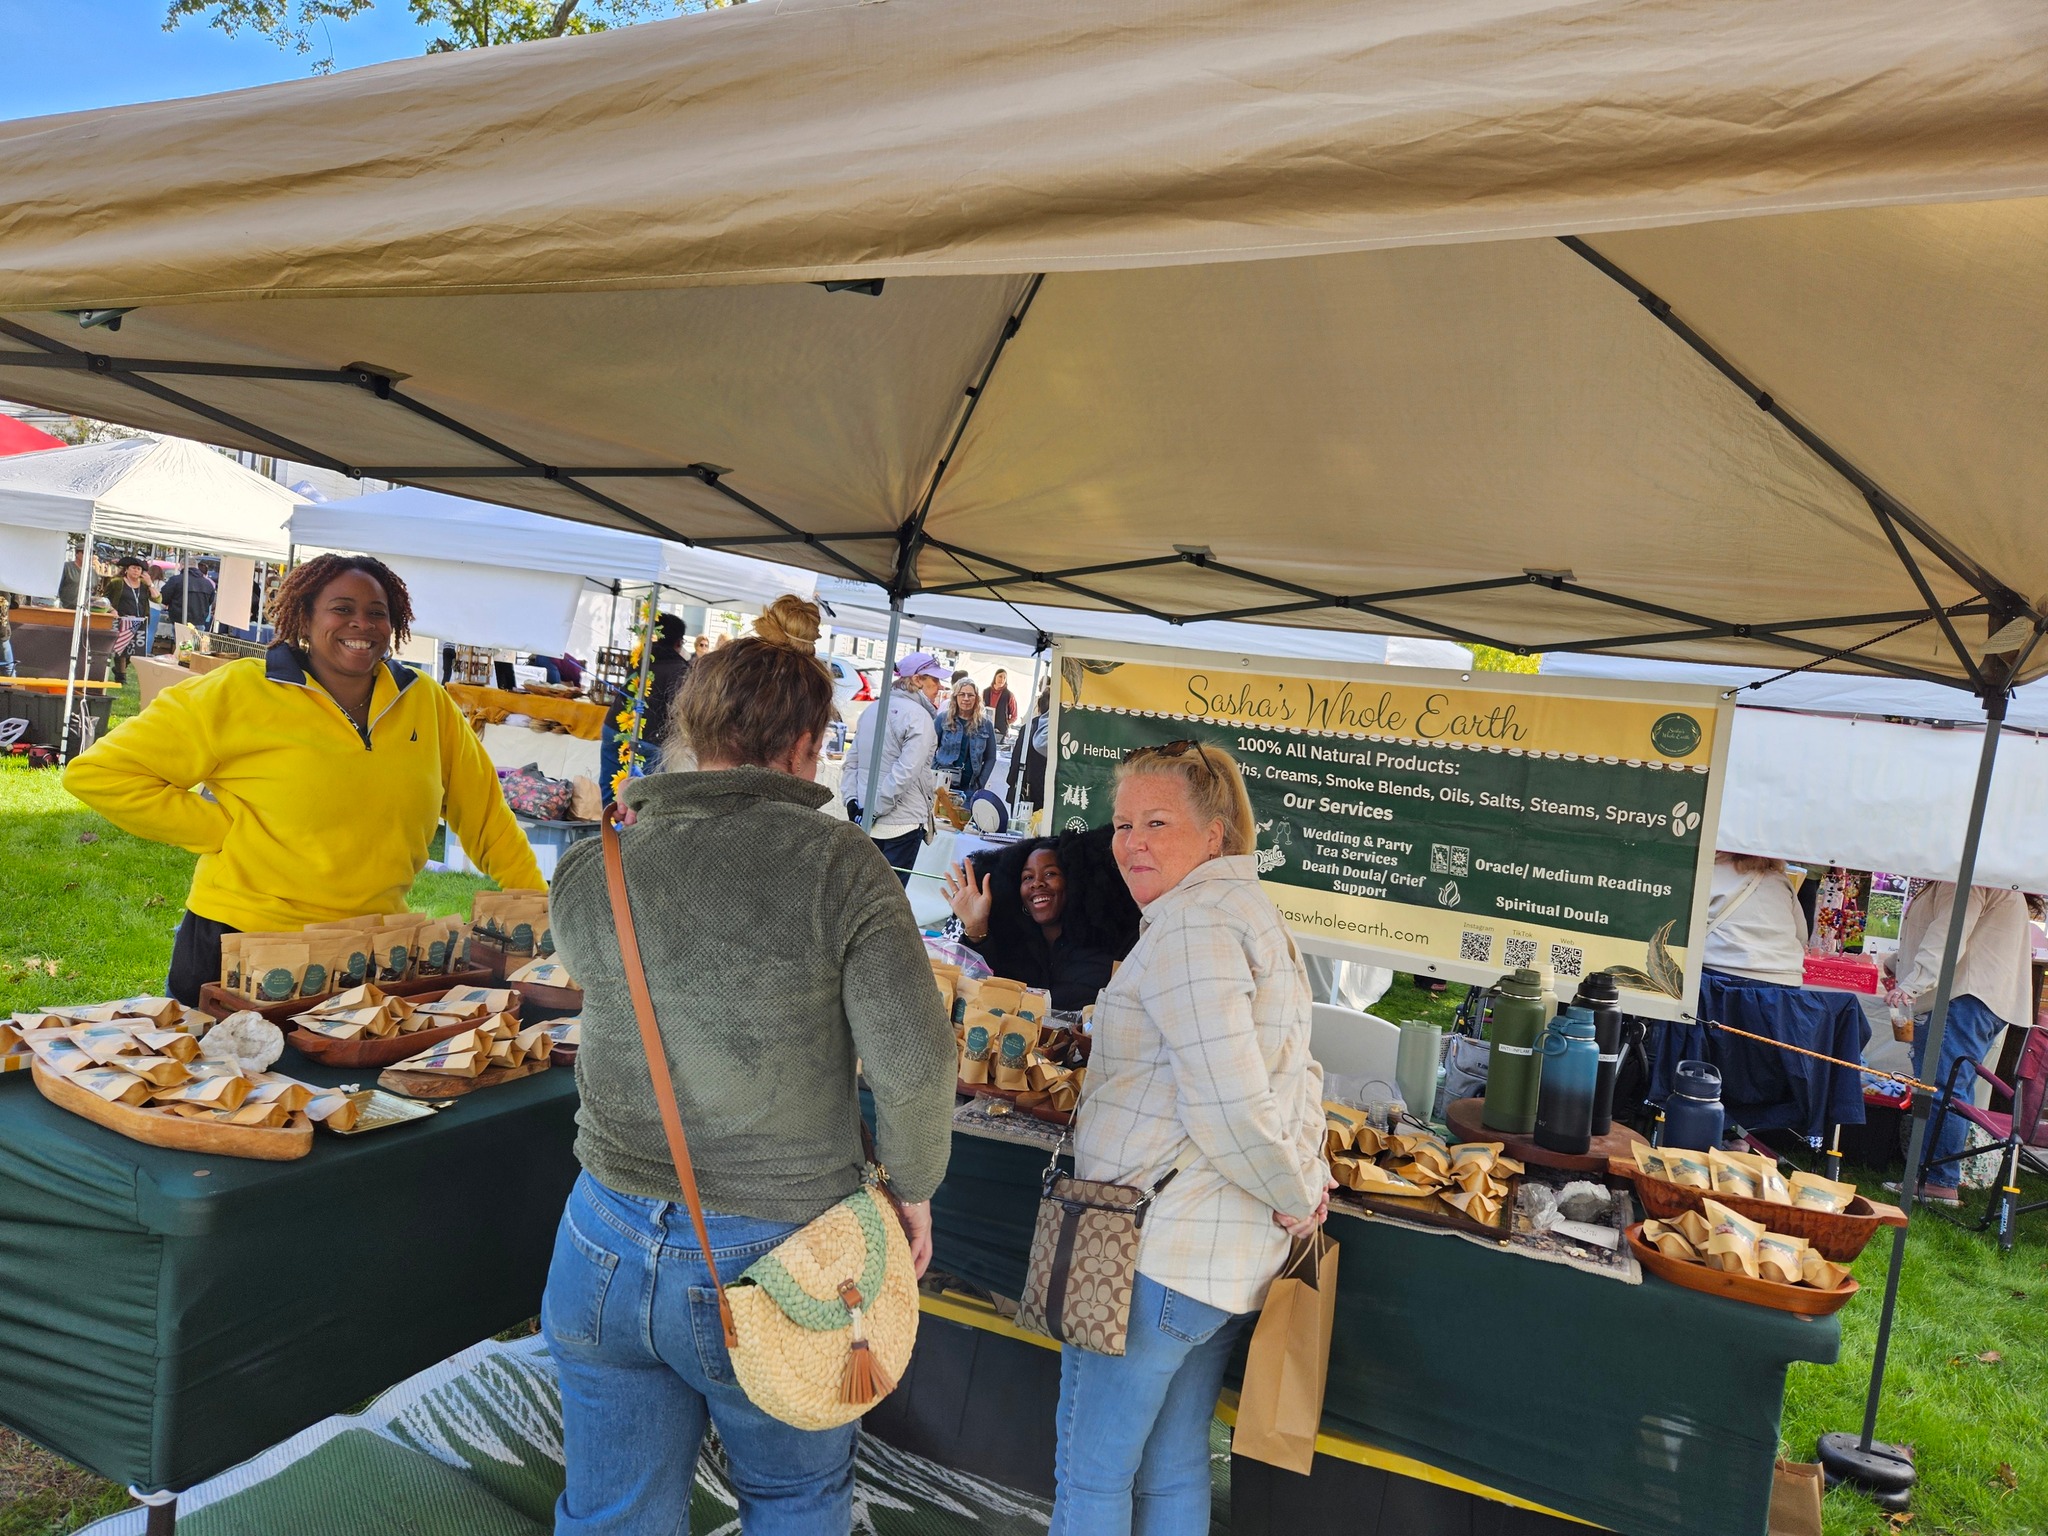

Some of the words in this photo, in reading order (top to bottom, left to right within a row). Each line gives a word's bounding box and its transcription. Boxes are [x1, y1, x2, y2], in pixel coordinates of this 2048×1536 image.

[1185, 674, 1296, 721] Sasha's
[1305, 682, 1407, 731] Whole
[1415, 694, 1528, 742] Earth
[1083, 743, 1120, 760] Herbal
[1237, 736, 1282, 755] 100%
[1285, 742, 1307, 759] All
[1310, 745, 1372, 767] Natural
[1376, 751, 1460, 776] Products:
[1265, 766, 1322, 787] Creams,
[1326, 772, 1375, 792] Smoke
[1378, 779, 1435, 801] Blends,
[1439, 786, 1474, 807] Oils,
[1479, 791, 1525, 812] Salts,
[1529, 797, 1600, 820] Steams,
[1605, 805, 1667, 829] Sprays
[1283, 792, 1315, 811] Our
[1318, 796, 1393, 822] Services
[1303, 826, 1360, 848] Wedding
[1363, 835, 1374, 847] &
[1377, 836, 1413, 856] Party
[1316, 843, 1338, 858] Tea
[1341, 848, 1398, 867] Services
[1302, 859, 1340, 876] Death
[1343, 865, 1387, 884] Doula/
[1390, 871, 1426, 888] Grief
[1475, 858, 1529, 879] Oracle/
[1532, 866, 1594, 886] Medium
[1598, 875, 1672, 897] Readings
[1333, 880, 1387, 898] Support
[1496, 895, 1560, 918] Spiritual
[1564, 907, 1609, 925] Doula
[1463, 922, 1495, 933] Instagram
[1512, 929, 1533, 938] TikTok
[1560, 938, 1575, 946] Web
